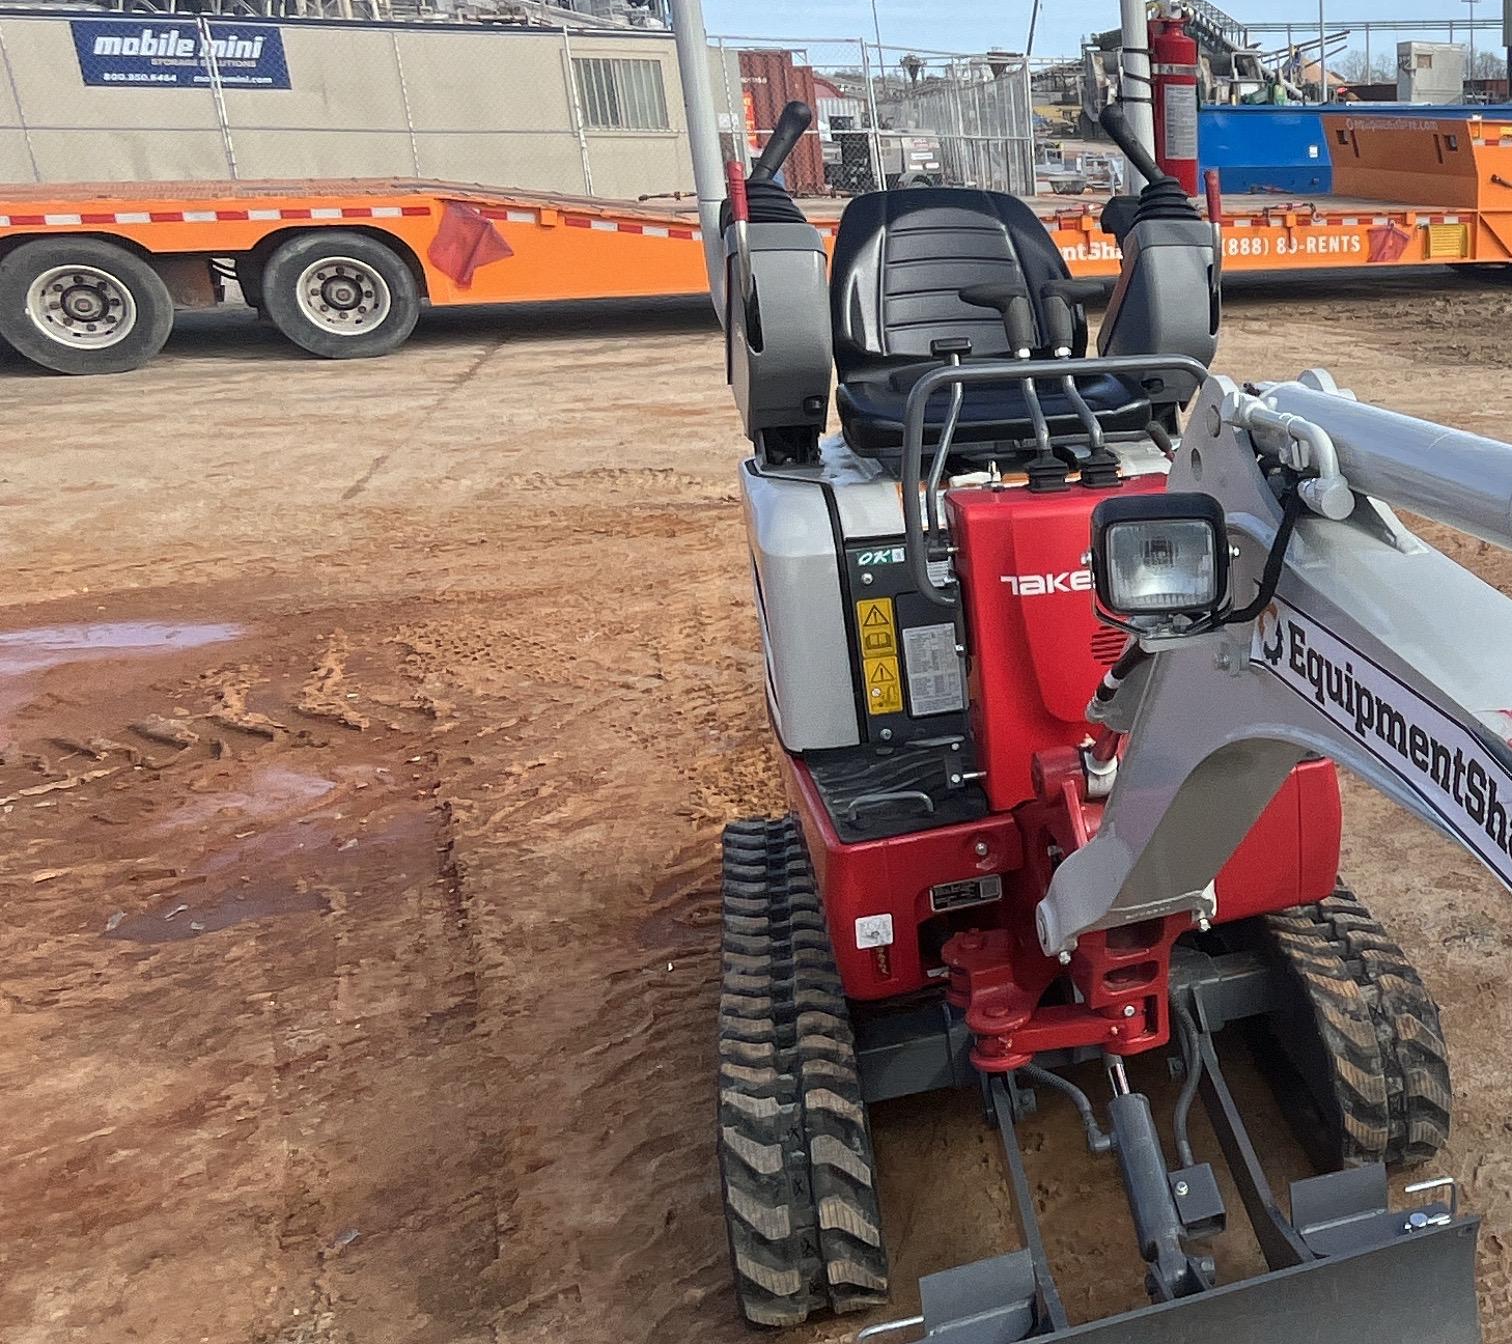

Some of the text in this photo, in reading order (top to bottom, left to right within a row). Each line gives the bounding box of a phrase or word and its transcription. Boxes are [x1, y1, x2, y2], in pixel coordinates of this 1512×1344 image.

[93, 28, 264, 59] mobile mini
[200, 58, 257, 68] SLUTIONS
[1221, 237, 1269, 256] (888)
[858, 549, 891, 565] OK
[1000, 569, 1095, 596] TAKE
